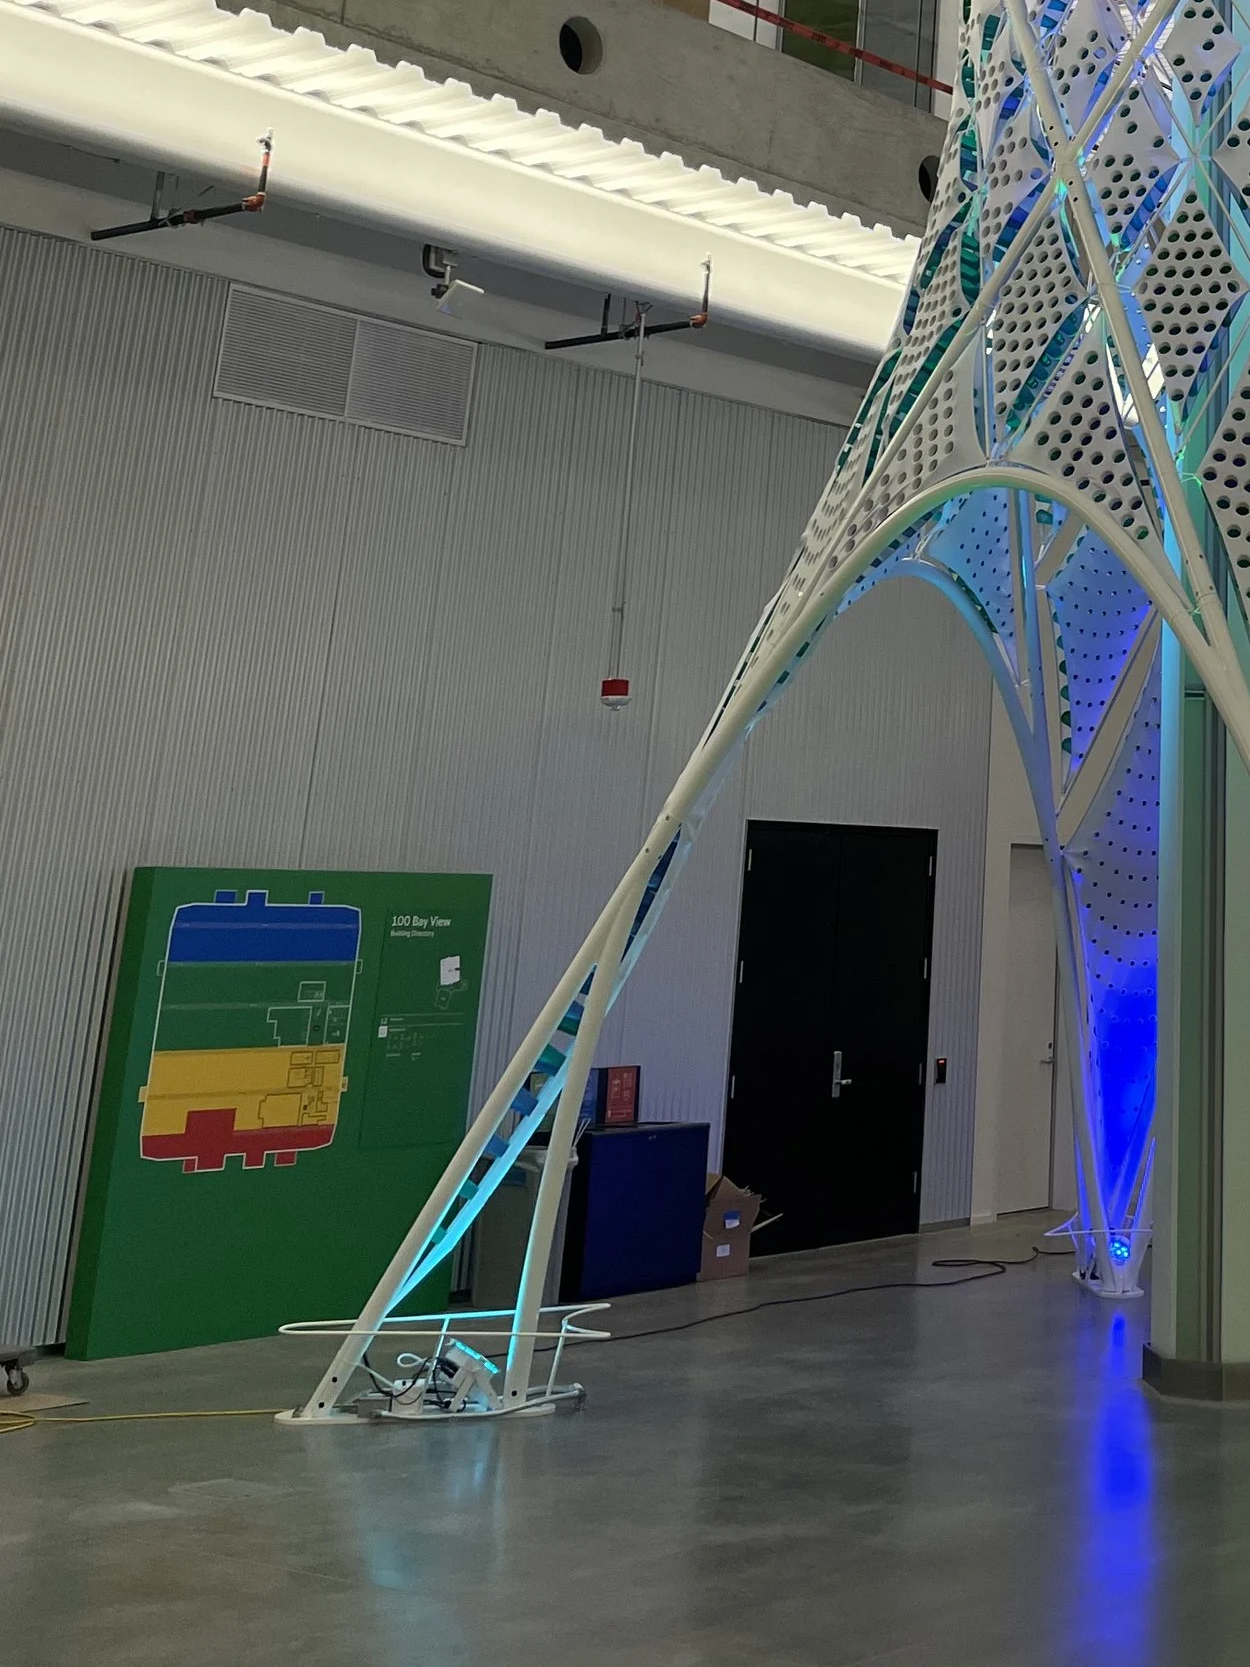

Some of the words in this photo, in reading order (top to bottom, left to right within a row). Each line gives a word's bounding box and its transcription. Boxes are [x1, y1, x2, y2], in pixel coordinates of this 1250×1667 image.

[391, 915, 411, 927] 100
[412, 916, 429, 930] Bay
[430, 916, 452, 927] View
